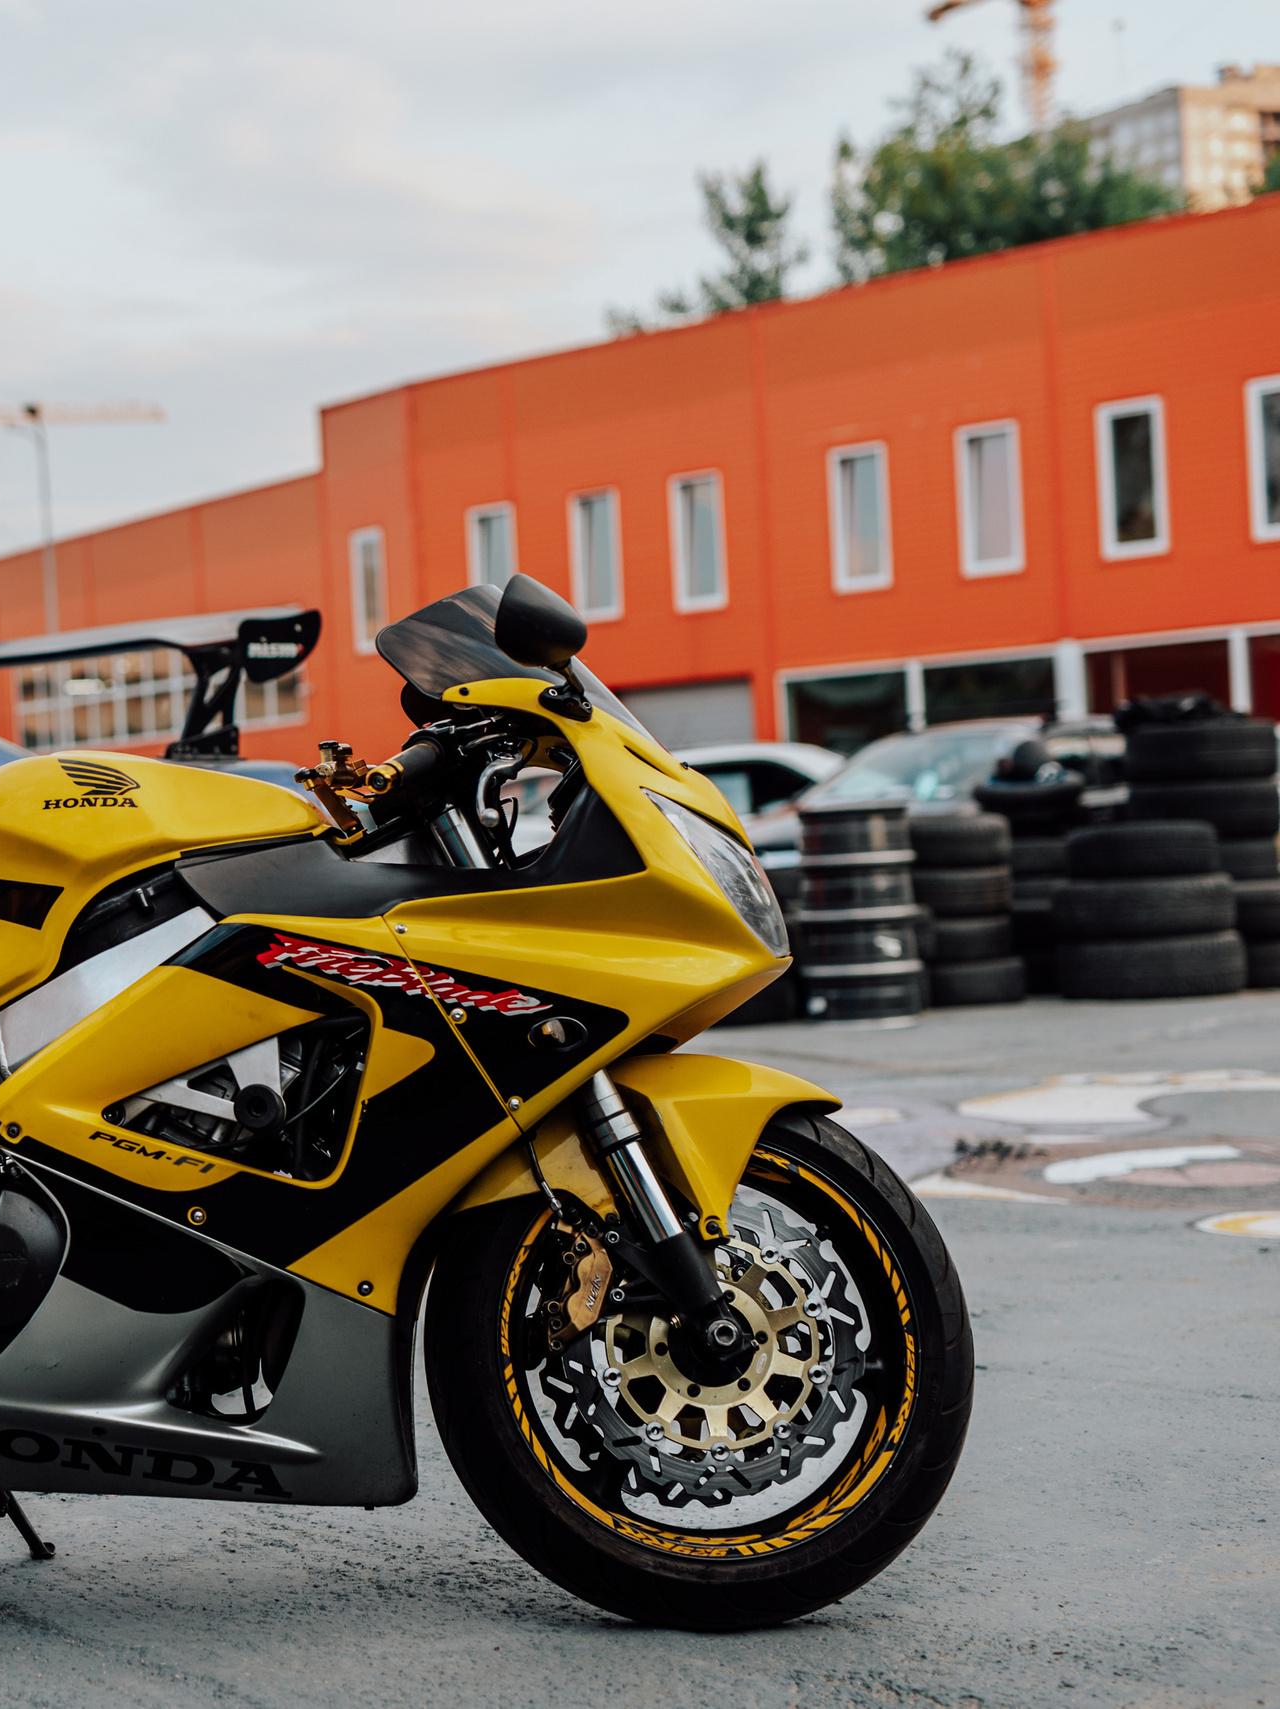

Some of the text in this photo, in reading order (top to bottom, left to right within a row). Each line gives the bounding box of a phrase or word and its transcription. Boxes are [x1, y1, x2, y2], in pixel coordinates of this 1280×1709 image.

[42, 797, 138, 810] HONDA
[88, 1131, 216, 1174] PGM-FI
[500, 1246, 531, 1357] 929RR
[888, 1331, 916, 1444] 929RR
[616, 1521, 730, 1558] 929RR
